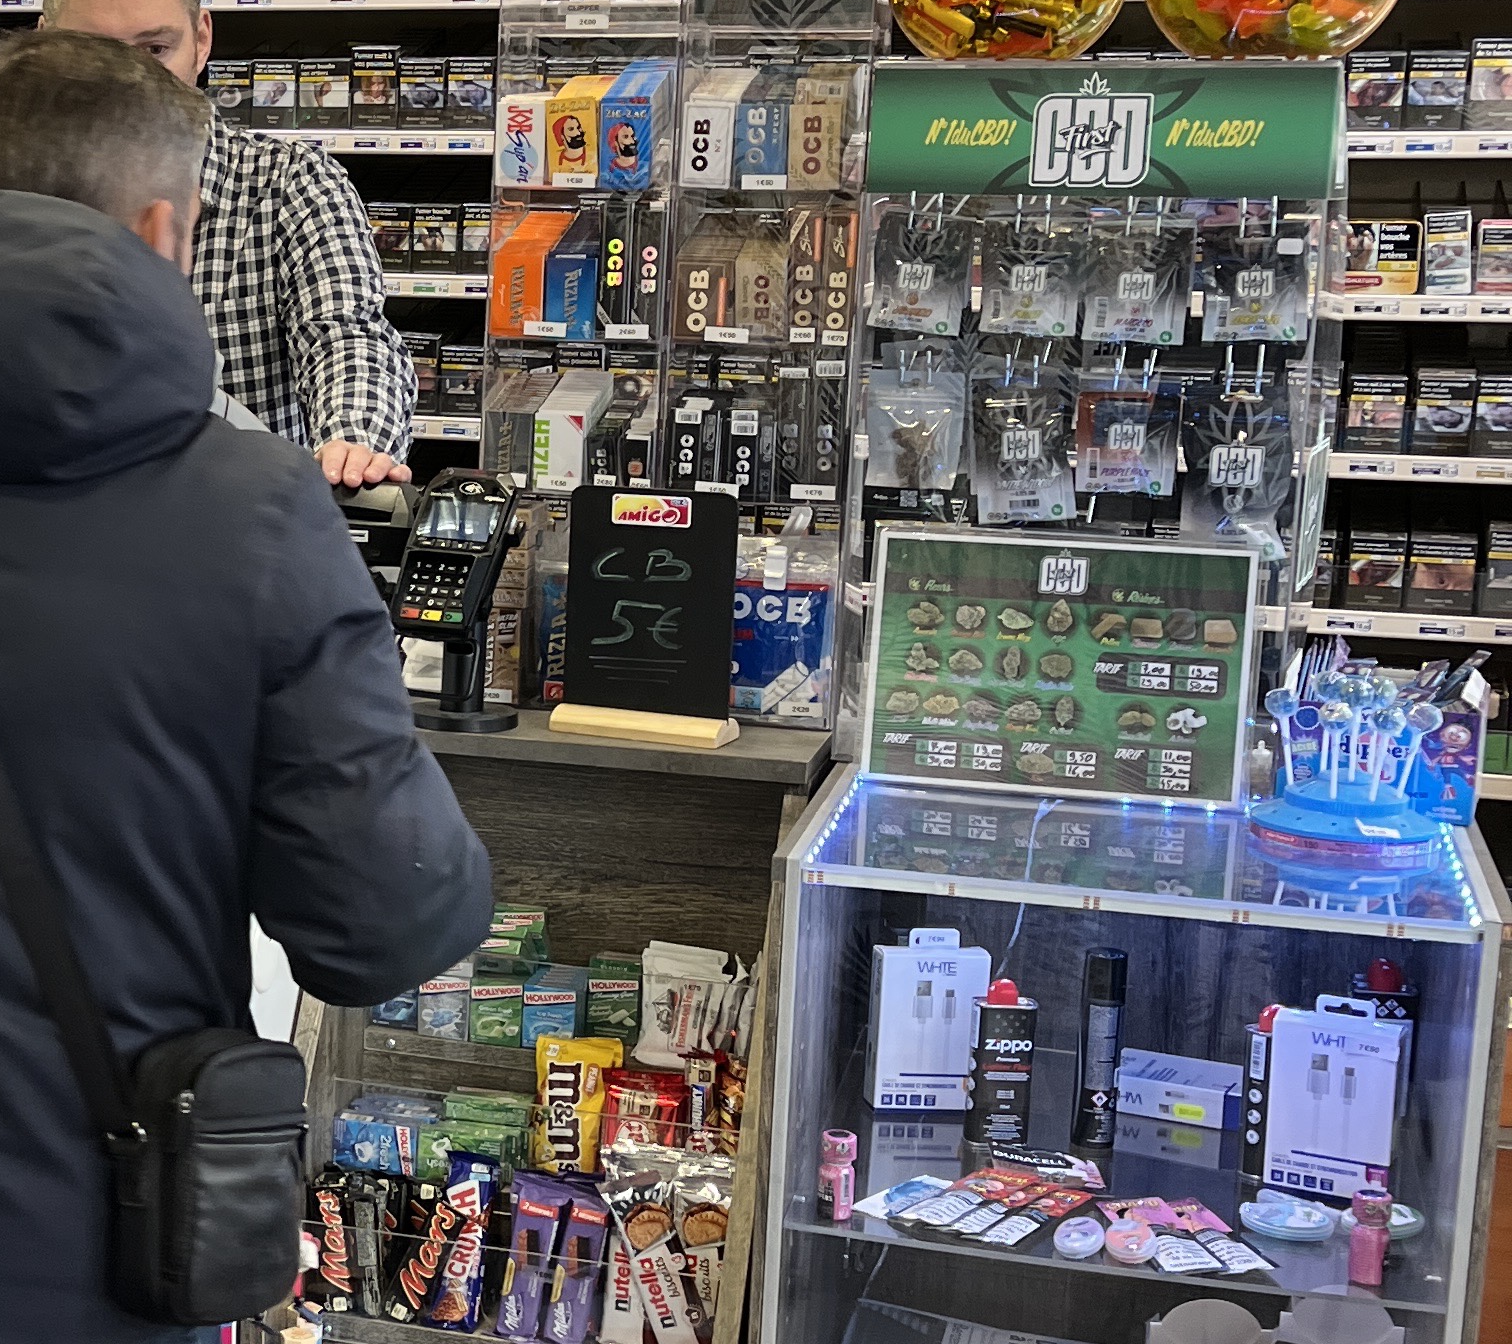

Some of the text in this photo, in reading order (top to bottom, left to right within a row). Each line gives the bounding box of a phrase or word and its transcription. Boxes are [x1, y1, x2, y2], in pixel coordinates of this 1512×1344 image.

[507, 105, 534, 134] JOB
[745, 108, 767, 165] OCB
[1028, 93, 1155, 188] CBD
[1059, 120, 1122, 152] First
[691, 118, 711, 171] OCB
[803, 114, 822, 175] OCB
[607, 238, 624, 287] OCB
[686, 269, 711, 332] OCB
[591, 600, 684, 650] 5€
[421, 981, 469, 991] HOLLYWOOD
[473, 986, 521, 997] HOLLYWOOD
[525, 992, 575, 1003] HOLLYWOOD
[985, 1039, 1033, 1053] zippo
[993, 1150, 1066, 1165] DURACELL
[317, 1190, 354, 1293] Mars
[399, 1203, 456, 1310] Mars
[447, 1185, 478, 1279] CRUNCH
[638, 1257, 677, 1330] nutella
[655, 1256, 682, 1299] biscuits
[701, 1257, 712, 1303] biscuits
[552, 1300, 572, 1338] Milka
